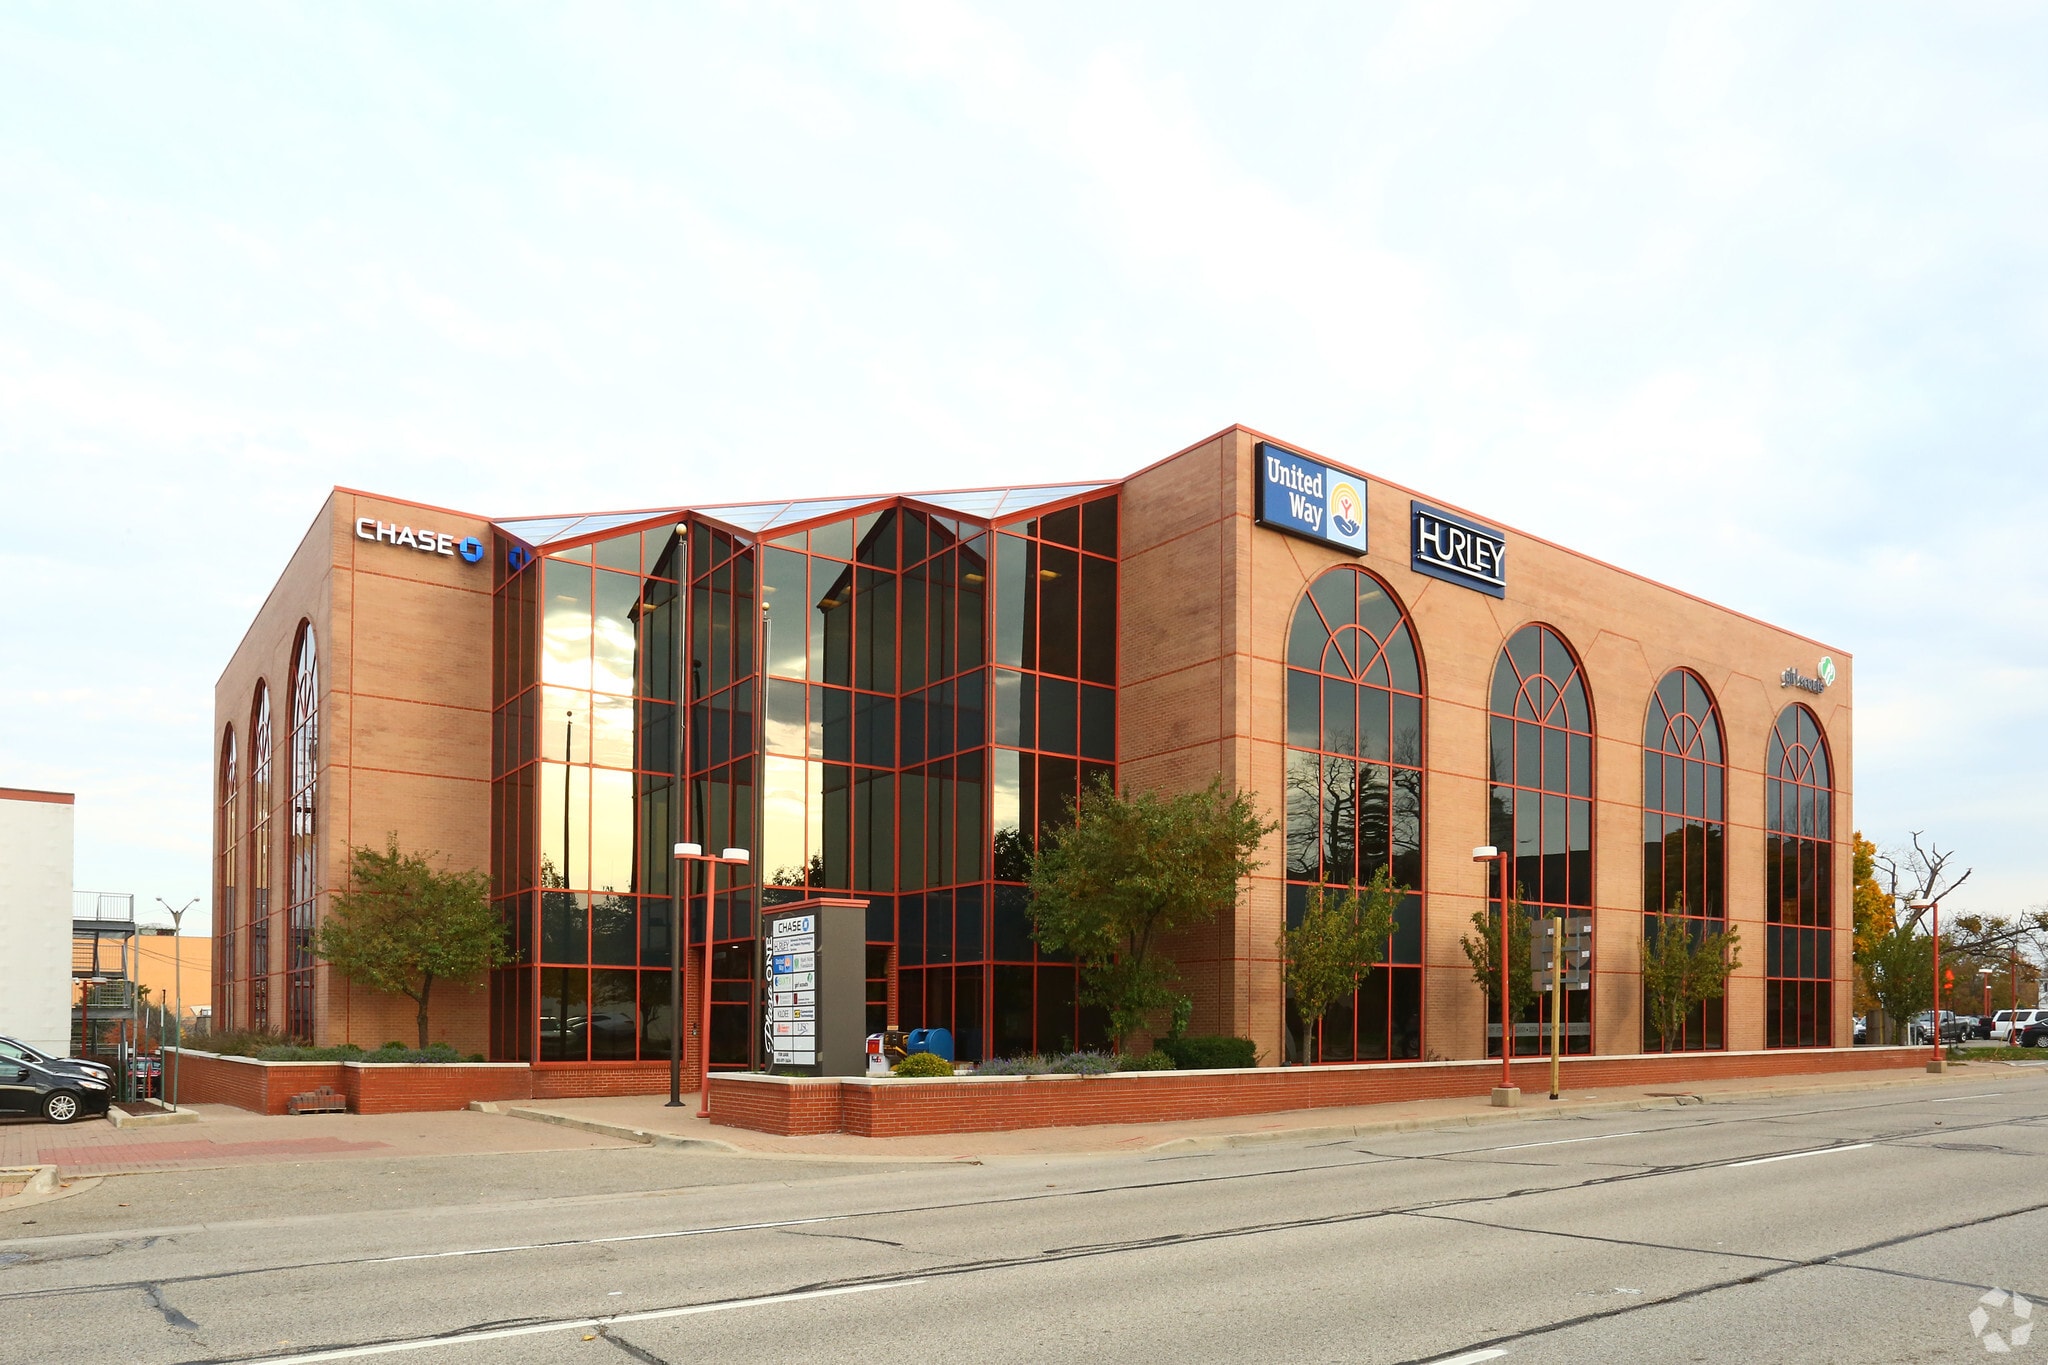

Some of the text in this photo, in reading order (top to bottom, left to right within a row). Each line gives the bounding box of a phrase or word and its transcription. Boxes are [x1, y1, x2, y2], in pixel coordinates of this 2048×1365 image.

[1266, 455, 1324, 499] United
[1288, 491, 1324, 532] Way
[355, 517, 455, 556] CHASE
[1419, 517, 1506, 578] HURLEY
[778, 920, 801, 934] CHASE
[765, 936, 774, 982] ONE
